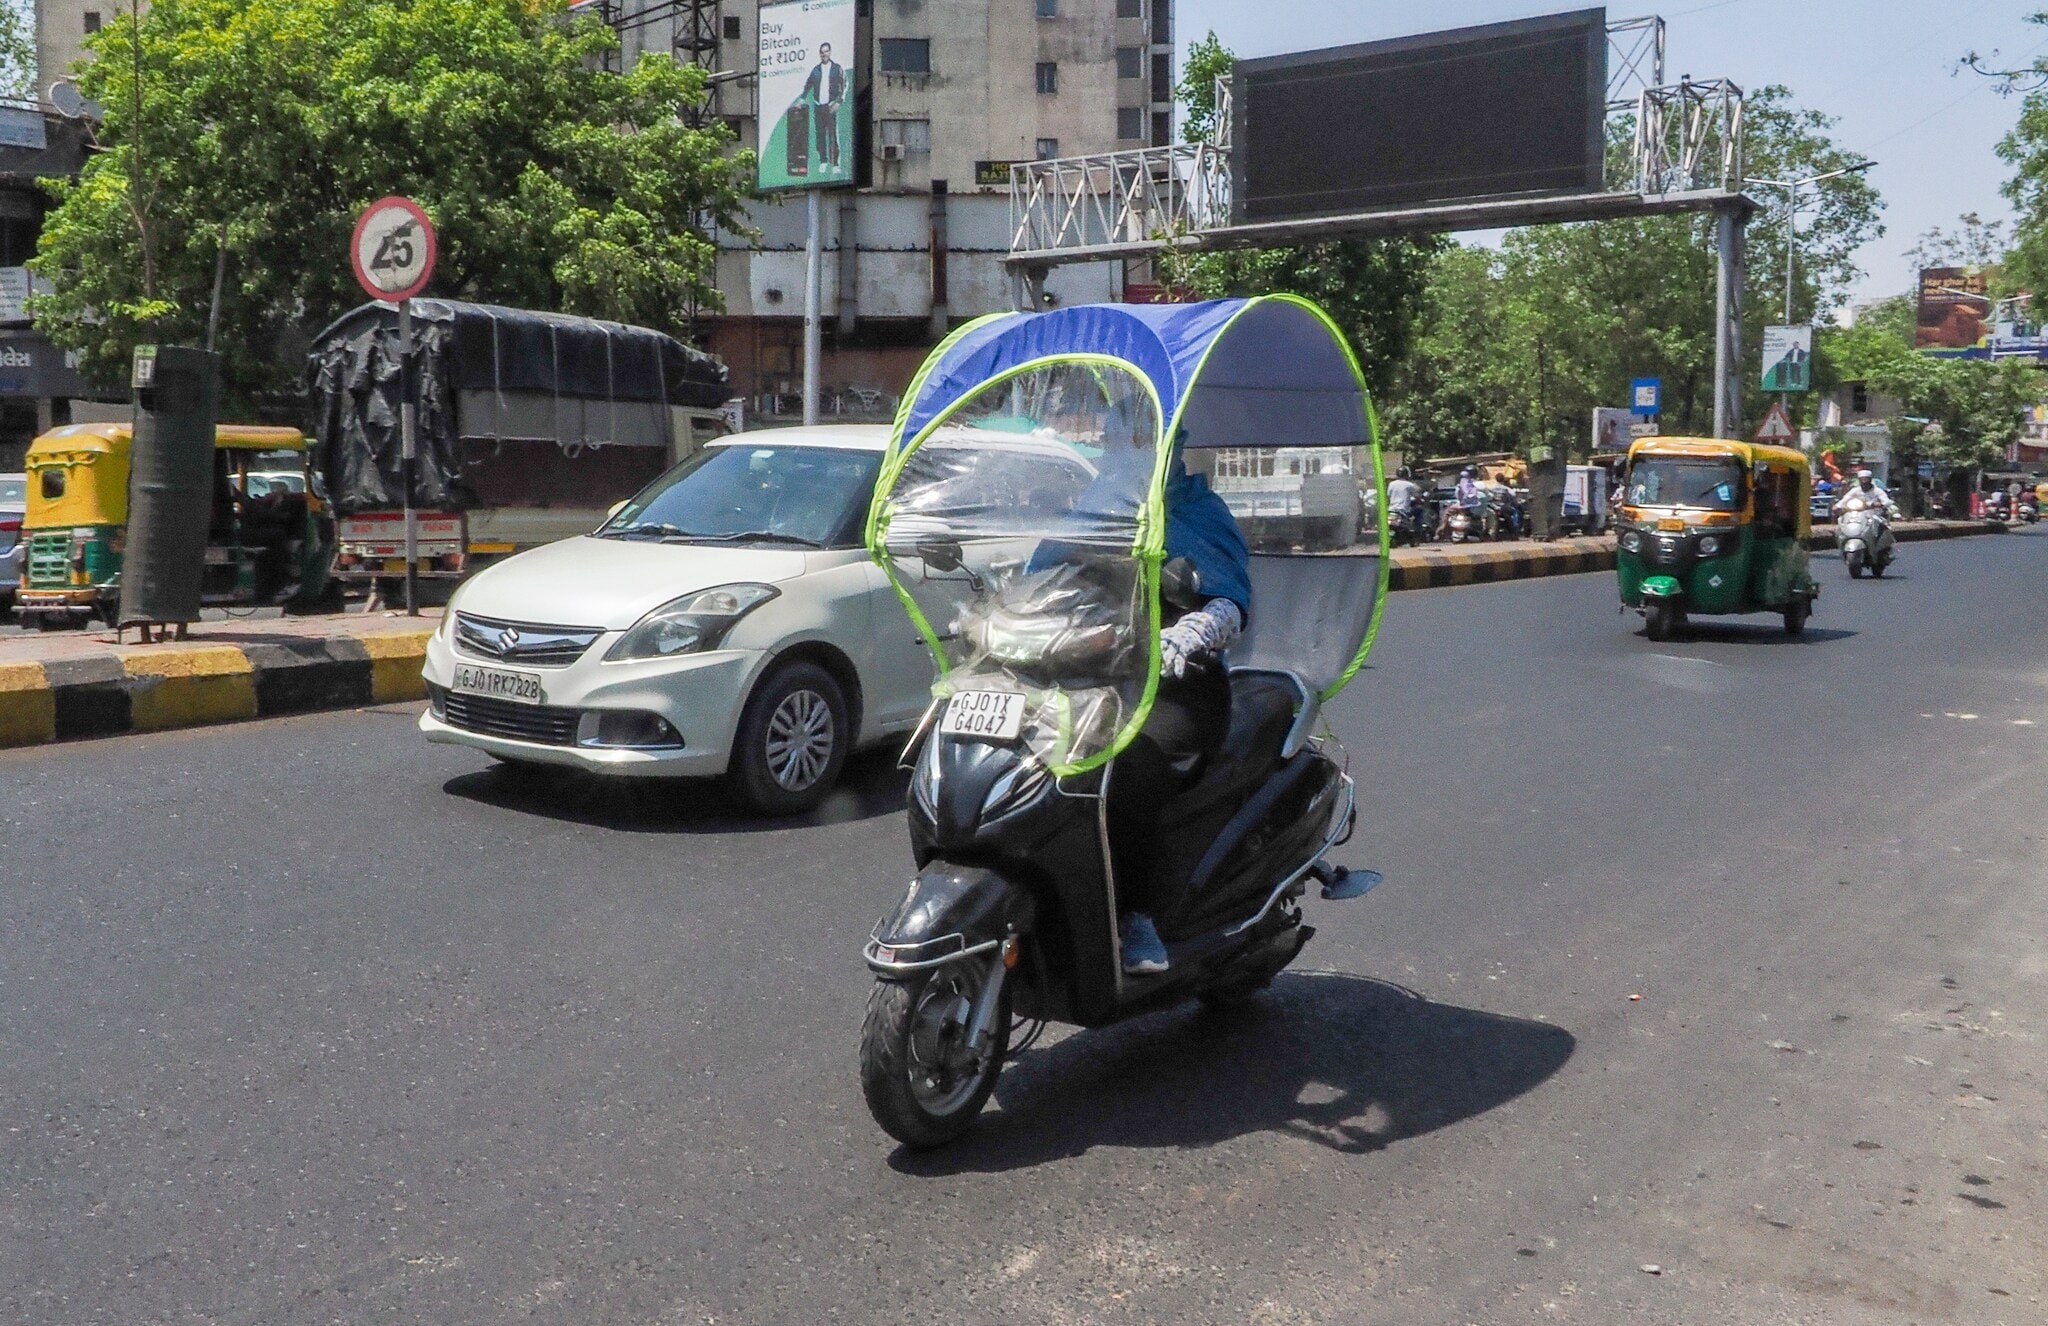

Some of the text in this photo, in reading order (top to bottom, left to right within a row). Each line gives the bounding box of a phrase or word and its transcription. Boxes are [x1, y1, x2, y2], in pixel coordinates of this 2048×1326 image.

[761, 23, 783, 35] Buy
[761, 35, 801, 50] Bitcoin
[760, 56, 772, 66] at
[961, 692, 1012, 714] GJ01X
[954, 712, 1007, 735] G4047
